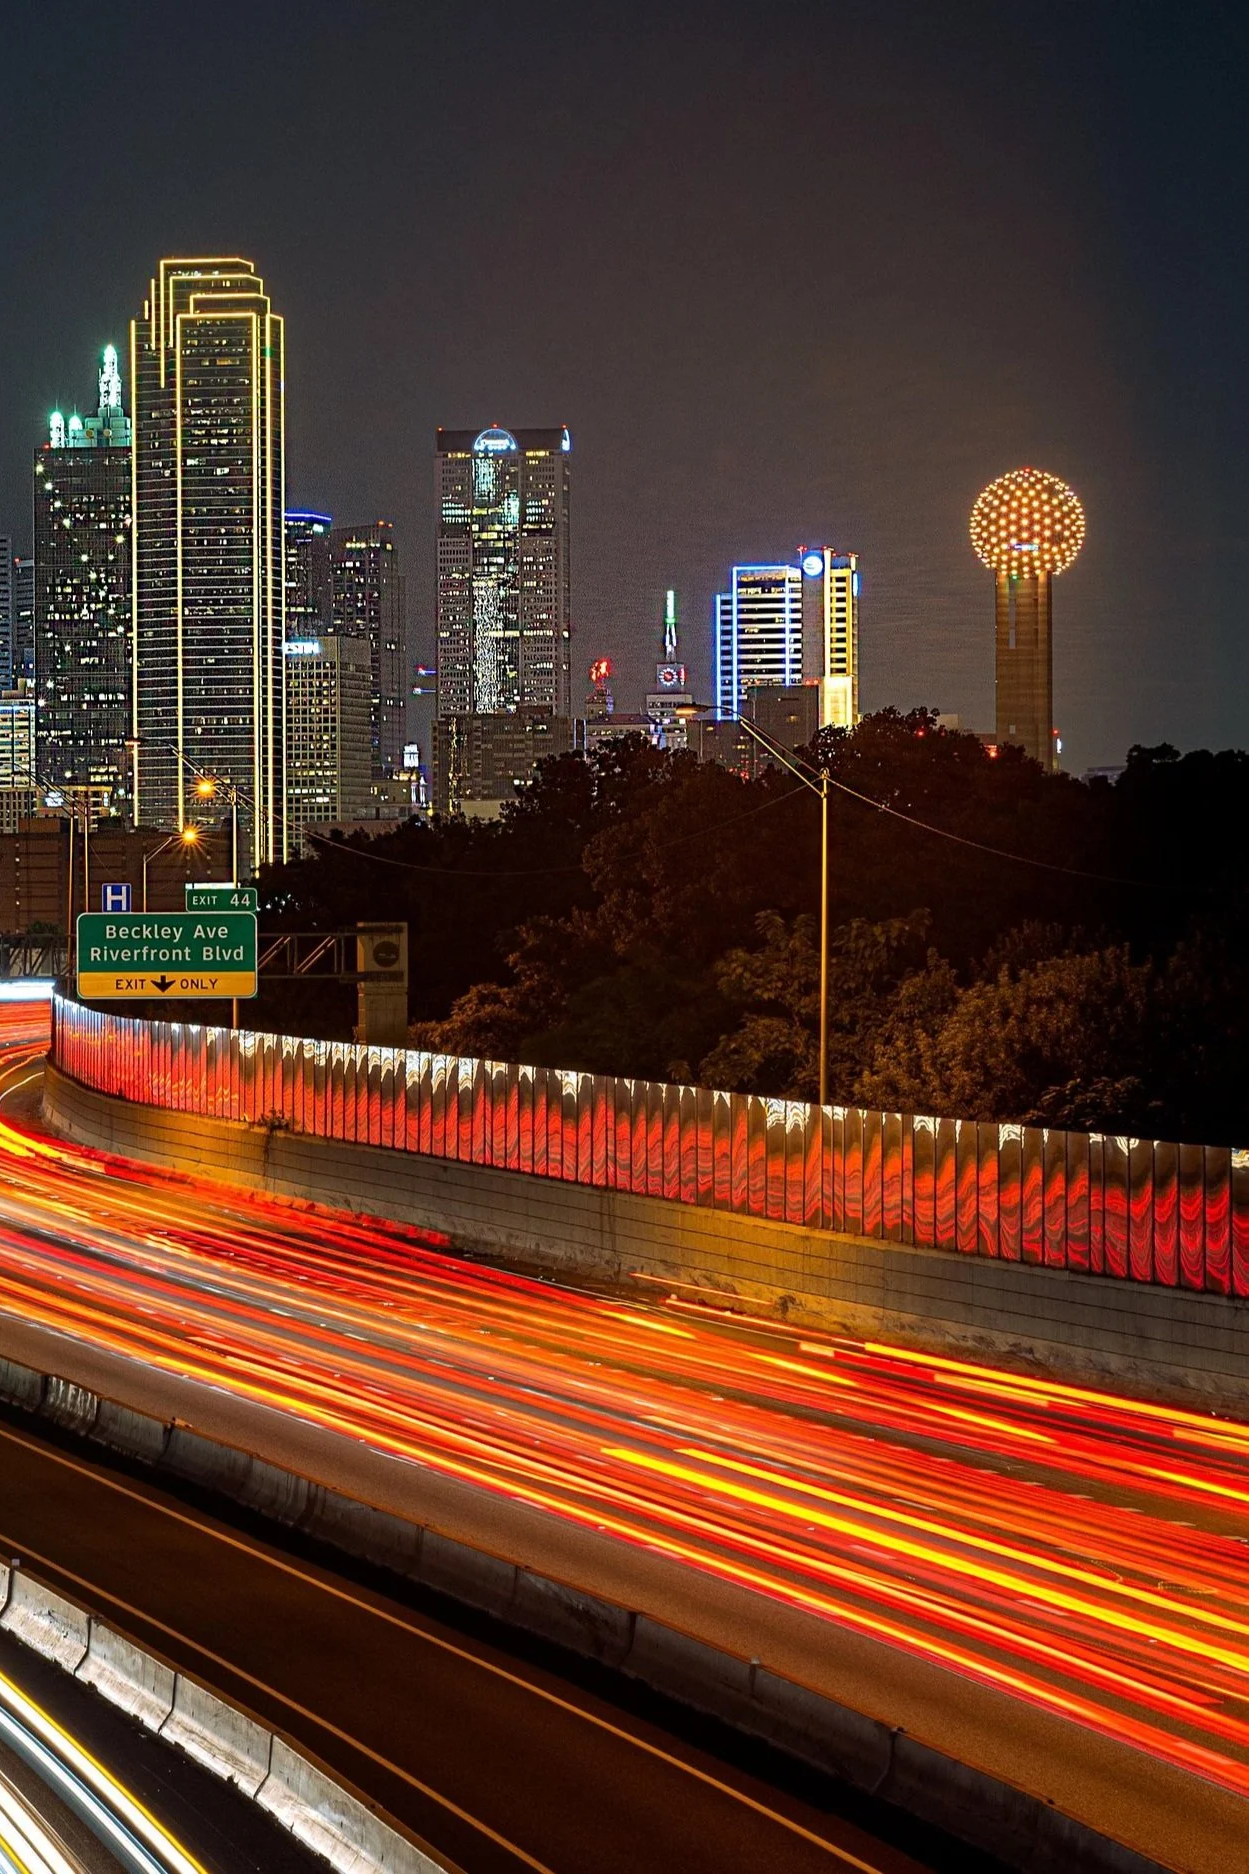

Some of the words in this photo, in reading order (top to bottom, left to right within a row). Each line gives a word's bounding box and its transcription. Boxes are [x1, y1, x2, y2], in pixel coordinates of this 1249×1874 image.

[106, 886, 127, 911] H
[192, 896, 218, 905] EXIT
[230, 894, 251, 907] 44
[105, 925, 183, 942] Beckley
[193, 925, 228, 939] Ave
[90, 946, 191, 961] Riverfront
[202, 946, 244, 961] Blvd
[115, 979, 146, 990] EXIT
[180, 979, 218, 990] ONLY
